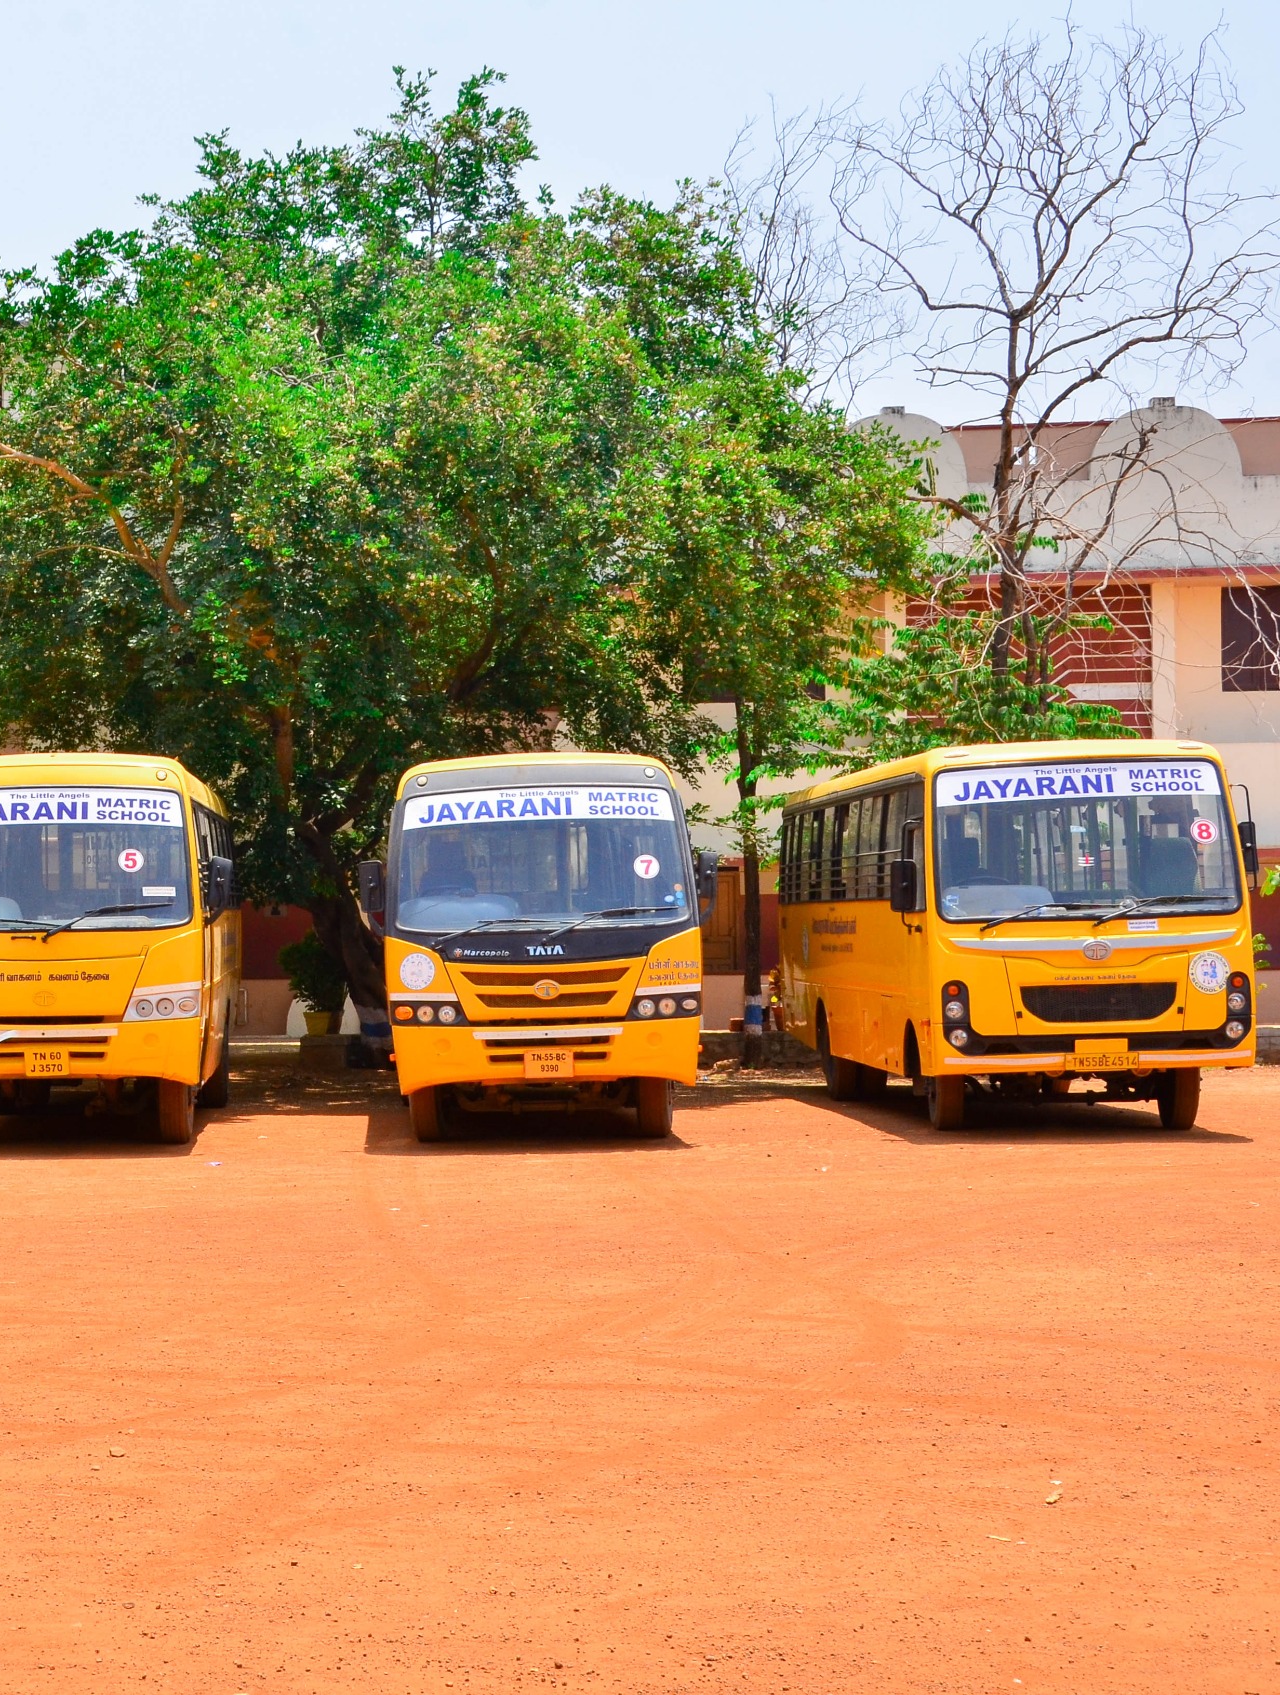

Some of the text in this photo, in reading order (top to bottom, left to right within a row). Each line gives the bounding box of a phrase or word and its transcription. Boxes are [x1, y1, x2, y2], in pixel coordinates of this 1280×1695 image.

[1084, 766, 1118, 774] Angels
[1128, 768, 1202, 780] MATRIC
[954, 774, 1114, 802] JAYARANI
[1131, 782, 1204, 792] SCHOOL
[58, 792, 90, 800] Angels
[588, 792, 658, 802] MATRIC
[96, 798, 171, 810] MATRIC
[96, 810, 170, 822] SCHOOL
[418, 797, 572, 824] JAYARANI
[588, 805, 659, 816] SCHOOL
[1197, 823, 1212, 840] 8
[124, 852, 138, 868] 5
[640, 860, 652, 875] 7
[526, 944, 564, 956] TATA
[6, 970, 42, 982] வாகனம்
[48, 970, 79, 982] கவனம்
[80, 971, 110, 983] தேவை
[1192, 978, 1218, 992] SCHOOL
[32, 1052, 62, 1060] TN 60
[531, 1053, 566, 1061] TN-55-BC
[1072, 1056, 1137, 1067] TN55BE4514
[30, 1064, 62, 1072] J 3570
[540, 1064, 558, 1072] 9390
